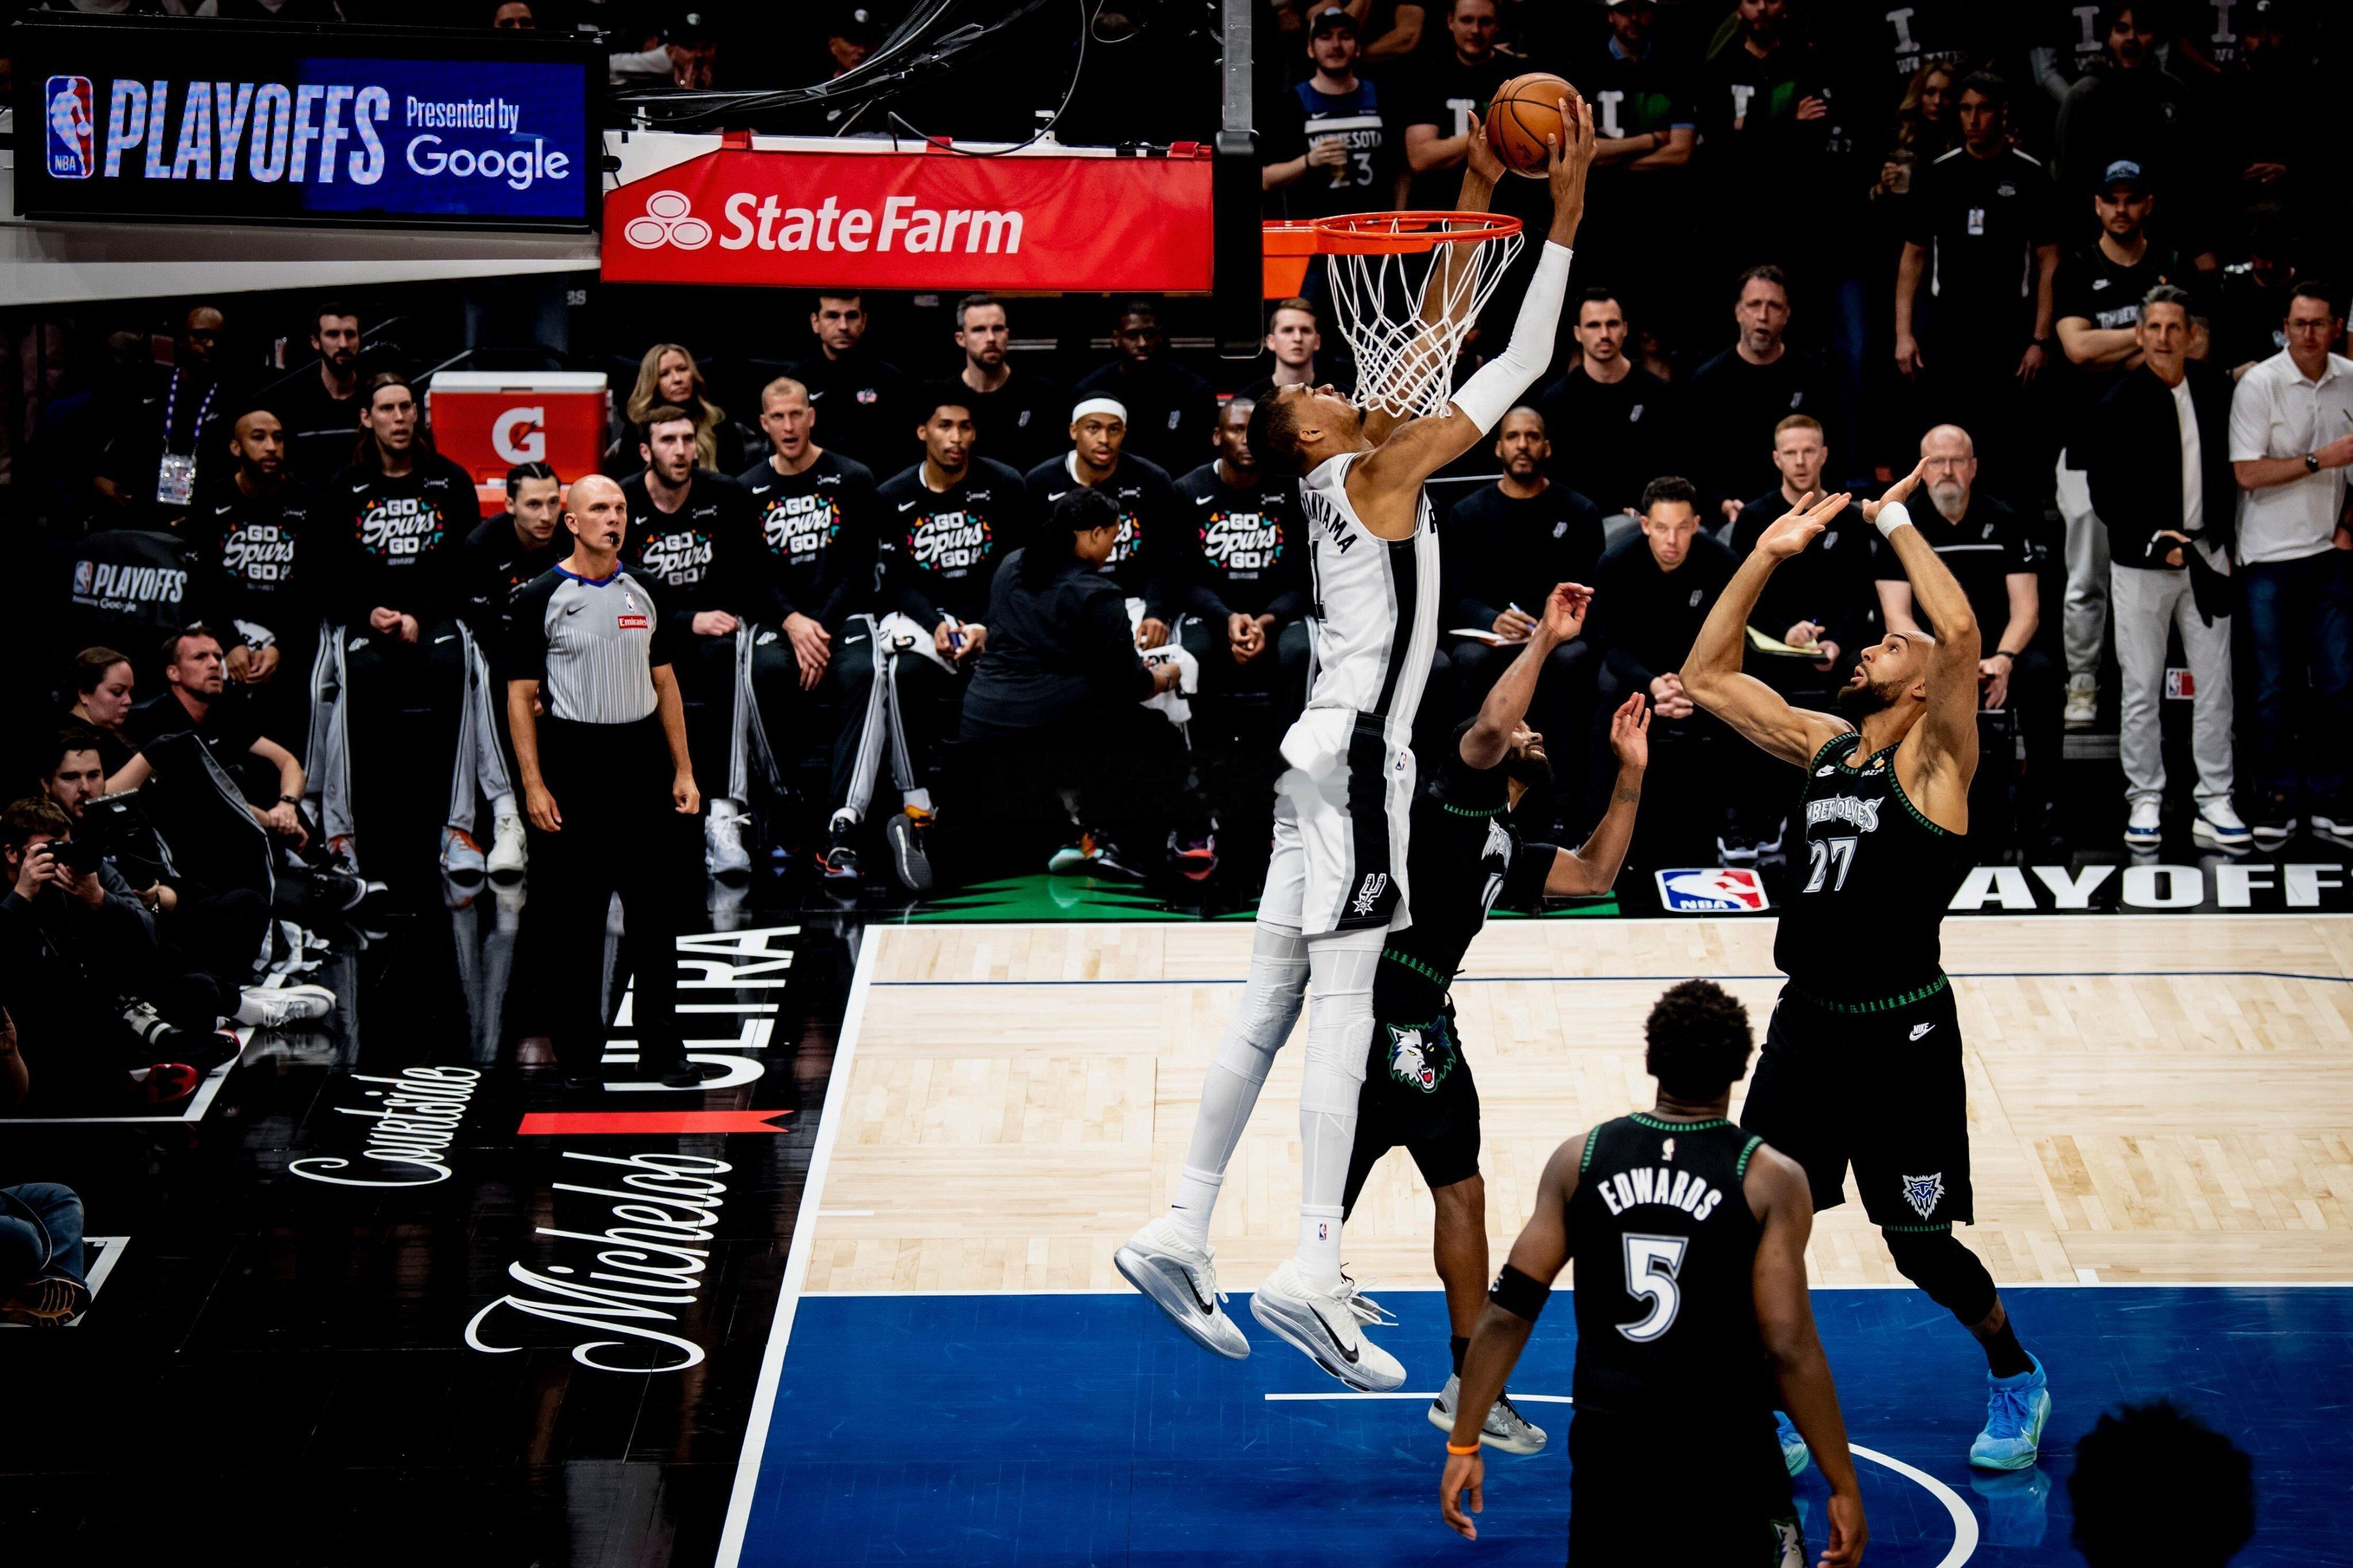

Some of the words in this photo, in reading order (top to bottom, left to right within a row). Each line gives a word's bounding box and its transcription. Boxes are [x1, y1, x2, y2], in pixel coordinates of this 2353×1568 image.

[104, 79, 390, 185] PLAYOFFS
[406, 95, 495, 129] Presented
[498, 98, 519, 134] by
[54, 155, 76, 172] NBA
[406, 134, 570, 190] Google
[387, 498, 419, 516] GO
[785, 495, 816, 515] GO
[934, 511, 965, 532] GO
[1229, 513, 1260, 531] GO
[247, 524, 279, 542] GO
[361, 506, 436, 548] Spurs
[665, 531, 695, 551] GO
[765, 505, 832, 548] Spurs
[914, 522, 984, 563] Spurs
[1204, 519, 1276, 561] Spurs
[222, 530, 295, 570] Spurs
[642, 540, 713, 580] Spurs
[92, 562, 188, 604] PLAYOFFS
[1802, 836, 1858, 894] 27
[1679, 899, 1729, 909] NBA
[1947, 863, 2344, 910] AYOFF
[288, 1065, 482, 1188] Courtside
[1597, 1167, 1722, 1221] EDWARDS
[464, 1150, 734, 1373] Michelob
[1615, 1231, 1689, 1343] 5
